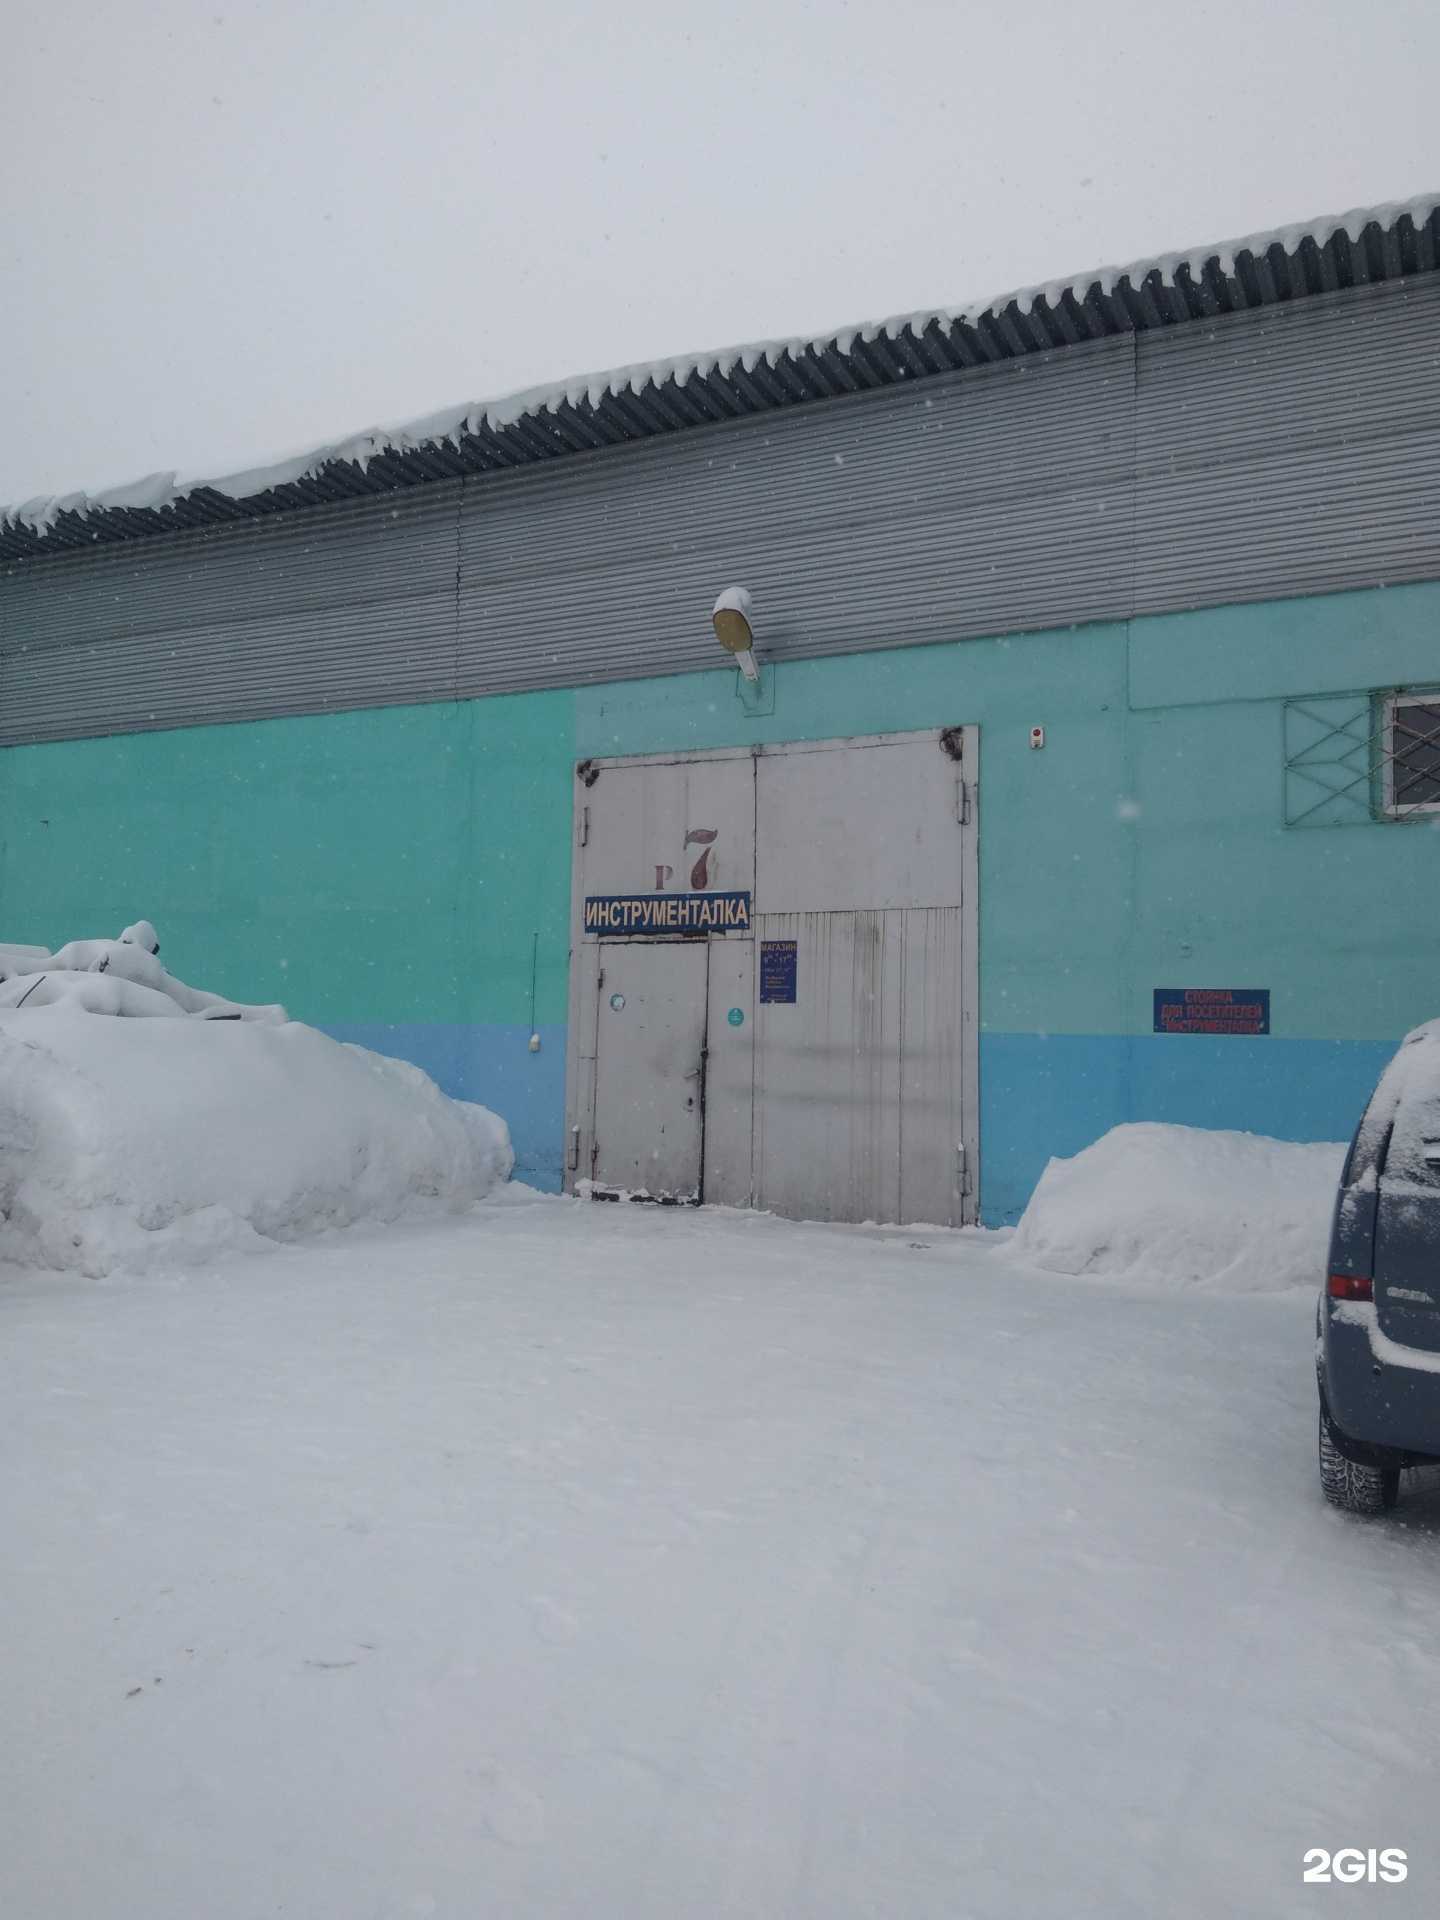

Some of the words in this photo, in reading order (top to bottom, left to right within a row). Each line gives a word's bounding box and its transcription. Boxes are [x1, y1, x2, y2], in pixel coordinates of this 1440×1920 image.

[683, 829, 718, 890] 7
[586, 899, 748, 927] ИНСТРУМЕНТАЛКА
[761, 943, 796, 952] МАГАЗИН
